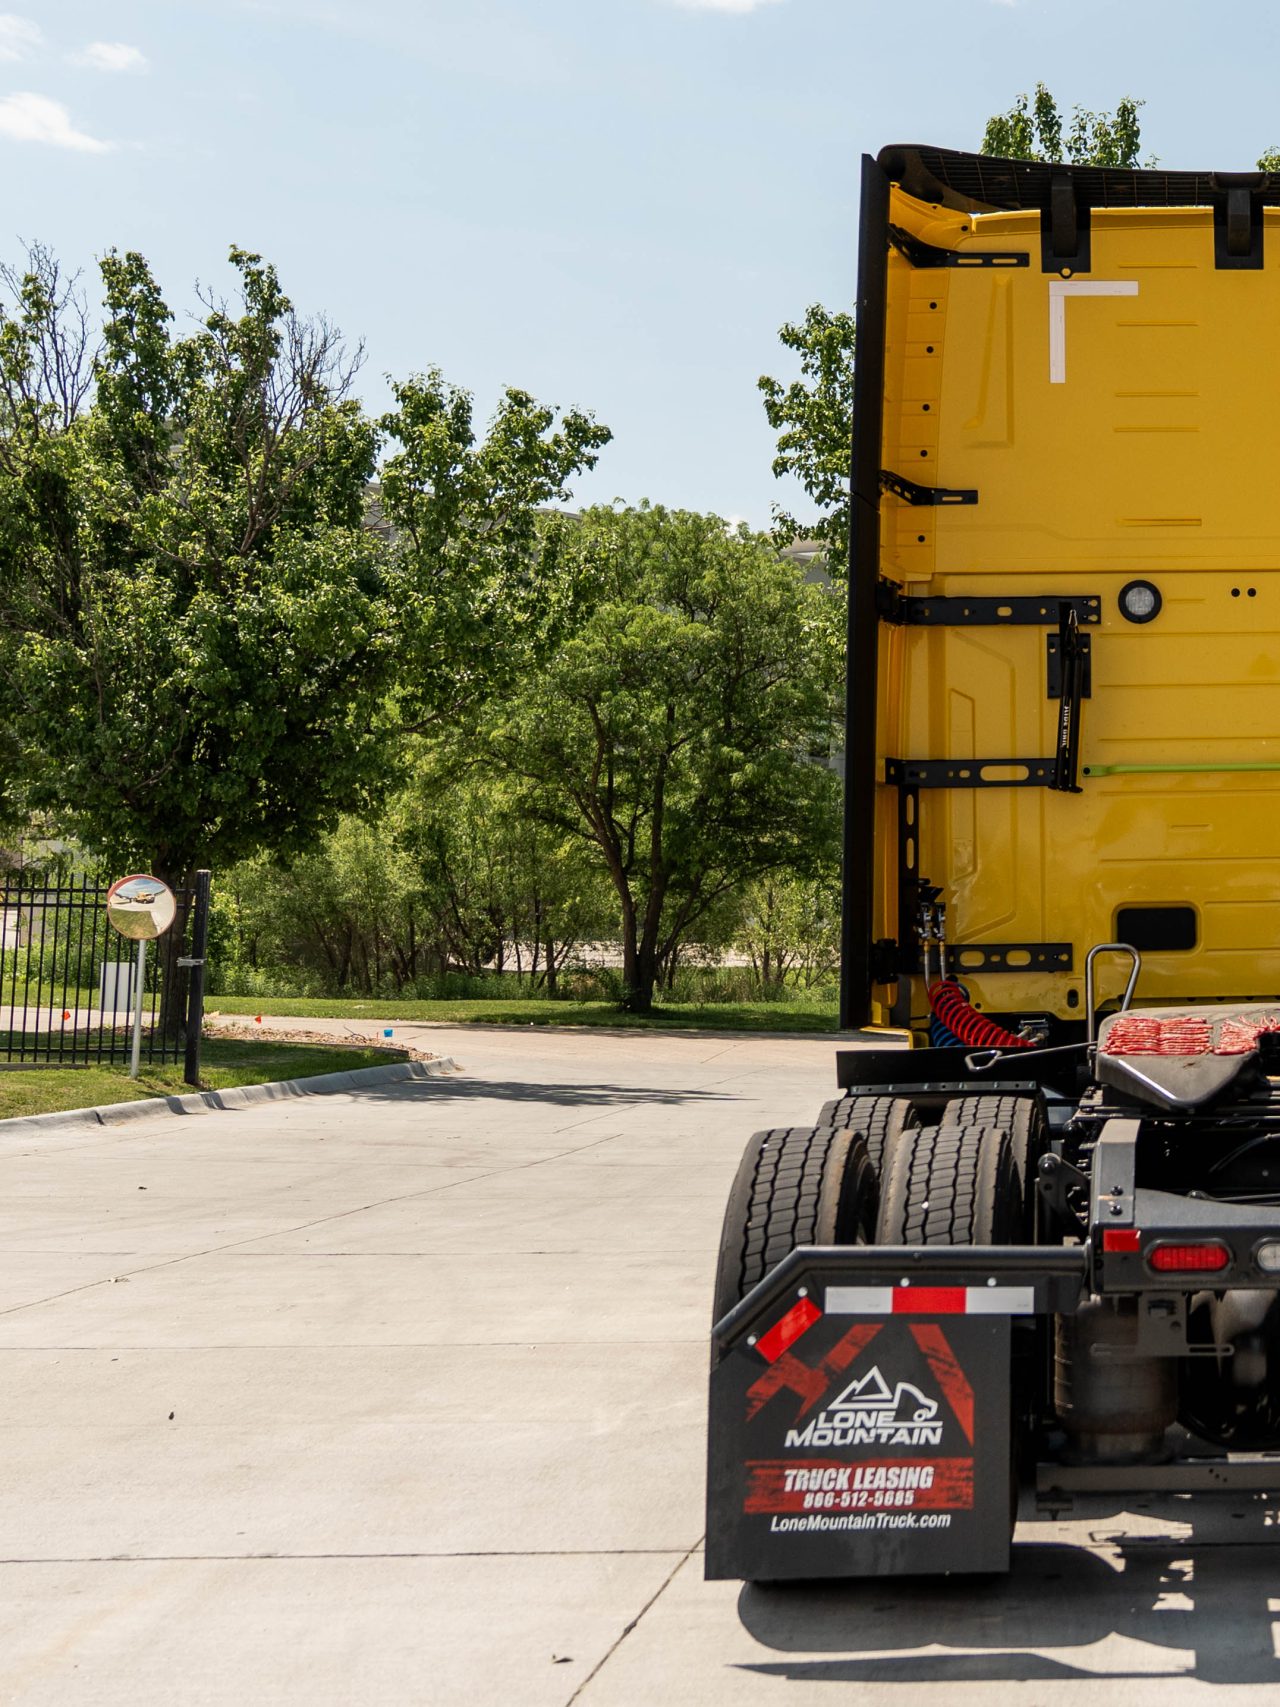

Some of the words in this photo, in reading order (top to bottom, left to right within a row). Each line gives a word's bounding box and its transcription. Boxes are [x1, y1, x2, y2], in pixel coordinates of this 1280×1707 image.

[816, 1410, 897, 1429] LONE
[784, 1418, 943, 1447] MOUNTAIN
[784, 1467, 851, 1492] TRUCK
[852, 1466, 935, 1490] LEASING
[770, 1512, 951, 1532] LoneMountainTruck.com
